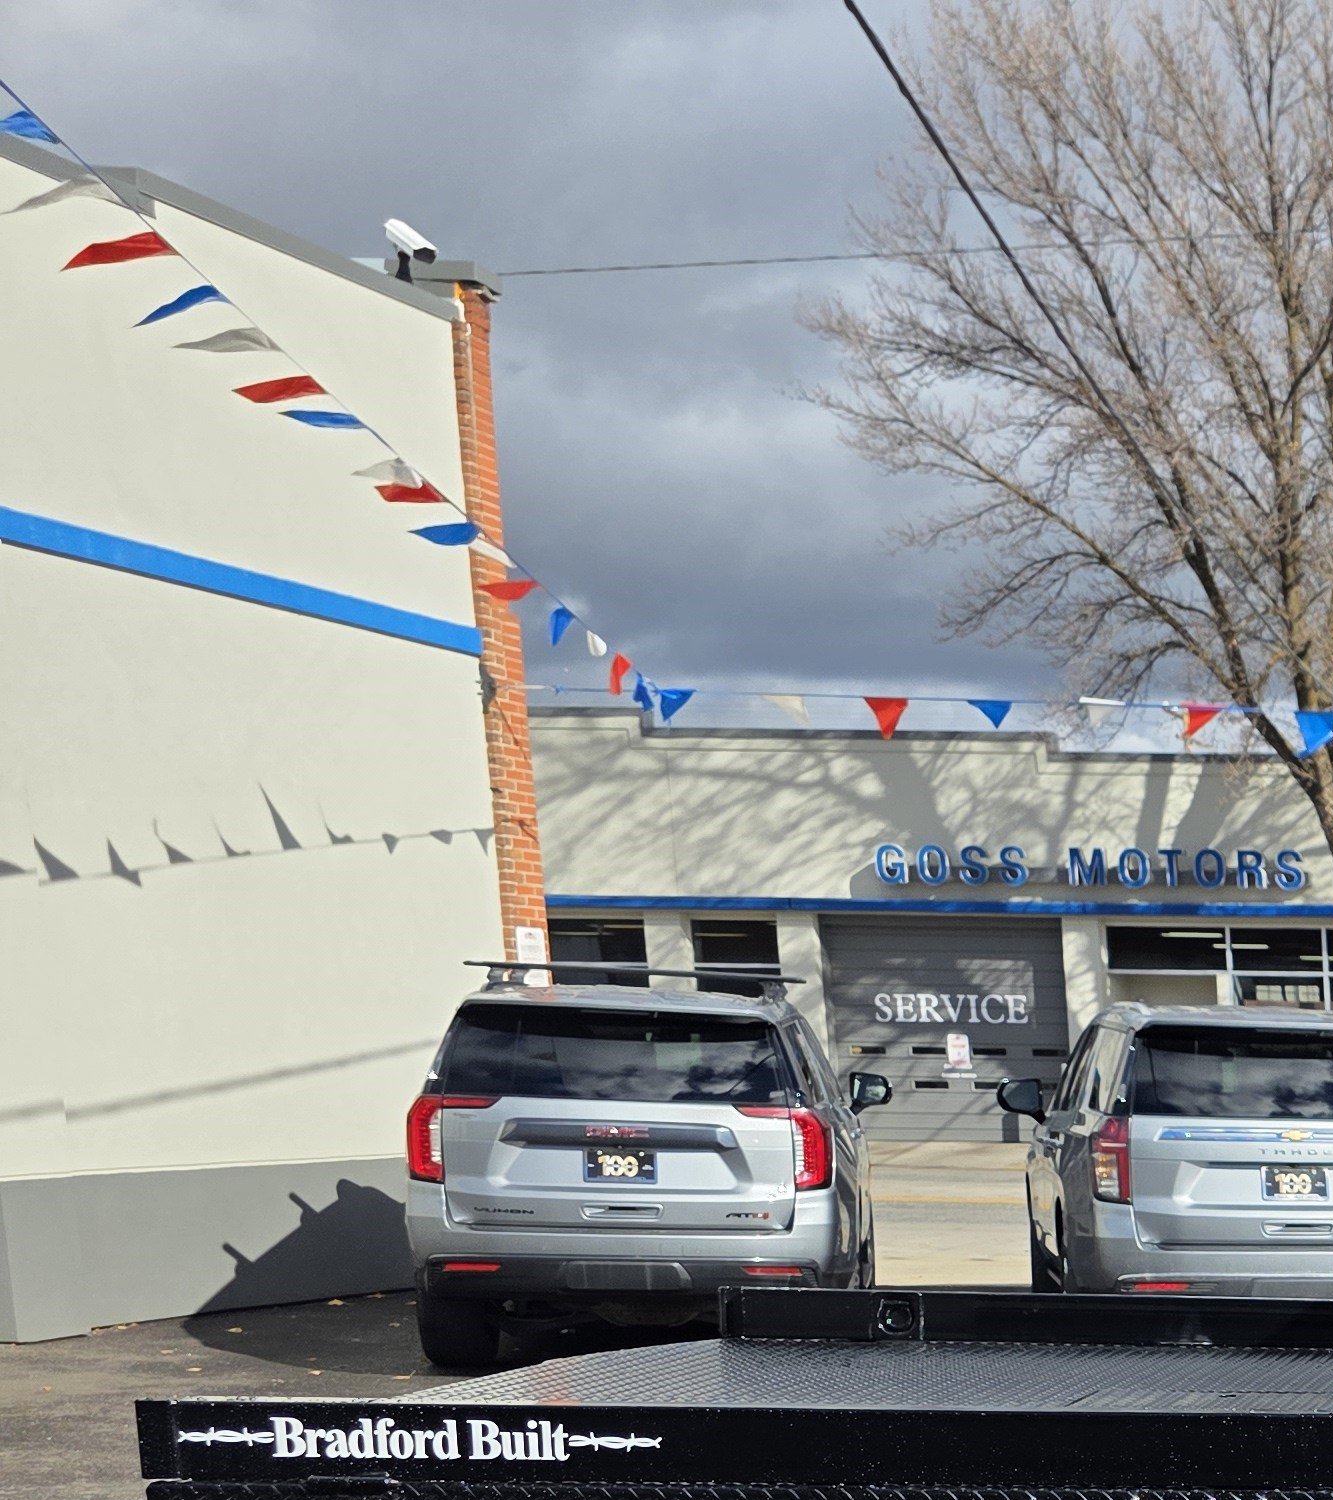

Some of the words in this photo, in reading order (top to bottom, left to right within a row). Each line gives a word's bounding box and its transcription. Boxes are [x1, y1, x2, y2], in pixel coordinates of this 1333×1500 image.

[873, 843, 1029, 887] GOSS
[1067, 846, 1308, 891] MOTORS
[873, 992, 1029, 1025] SERVICE
[269, 1416, 461, 1460] Bradford
[466, 1419, 571, 1463] Built
